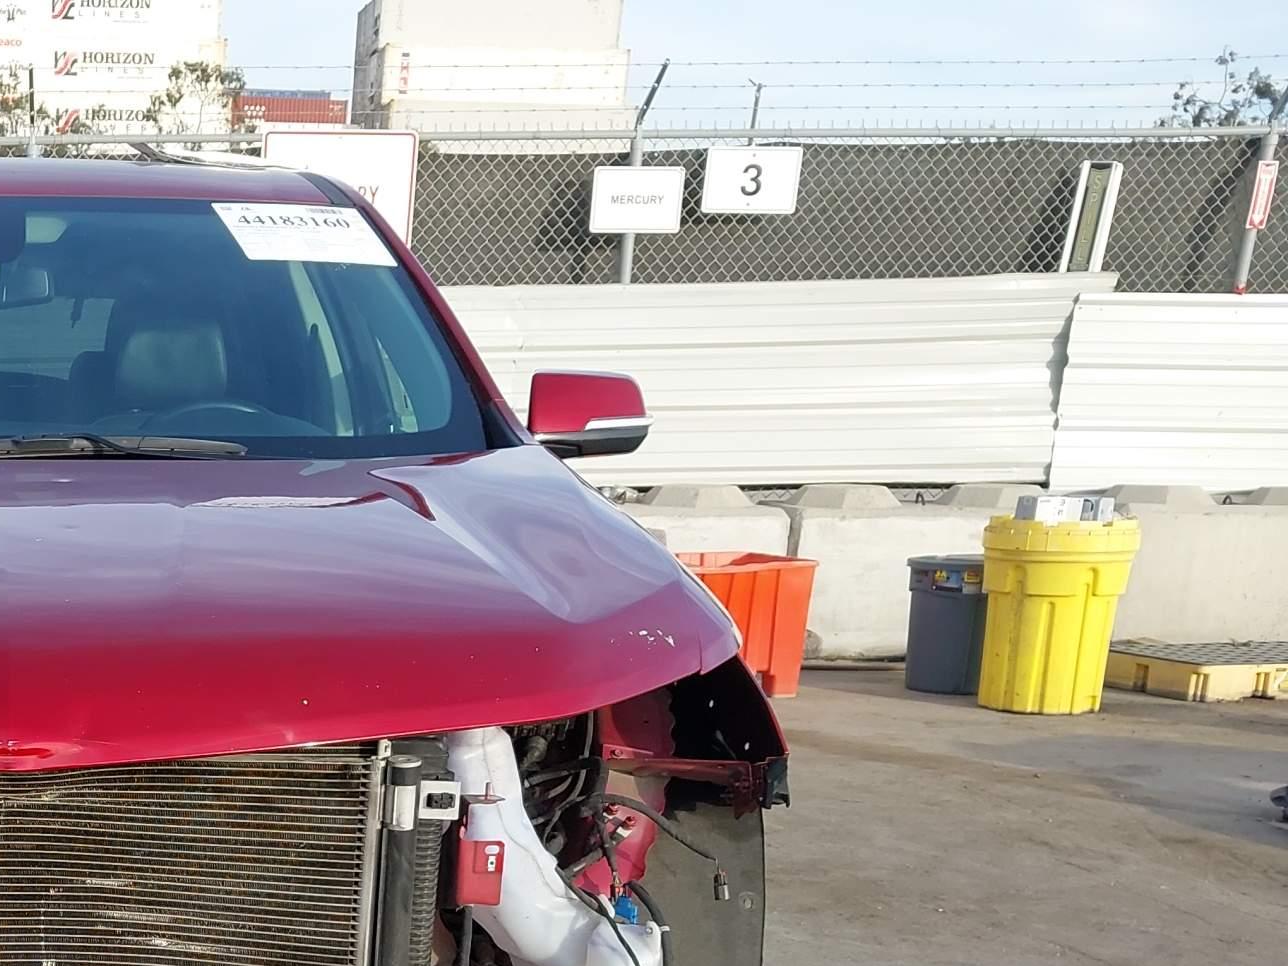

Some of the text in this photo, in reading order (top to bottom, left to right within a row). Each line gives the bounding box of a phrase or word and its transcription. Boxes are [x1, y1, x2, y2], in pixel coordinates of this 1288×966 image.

[80, 0, 152, 9] HORIZON
[78, 9, 141, 19] LINES
[82, 51, 155, 65] HORIZON
[740, 163, 763, 197] 3
[610, 194, 665, 205] MERCURY
[237, 214, 351, 229] 44183160
